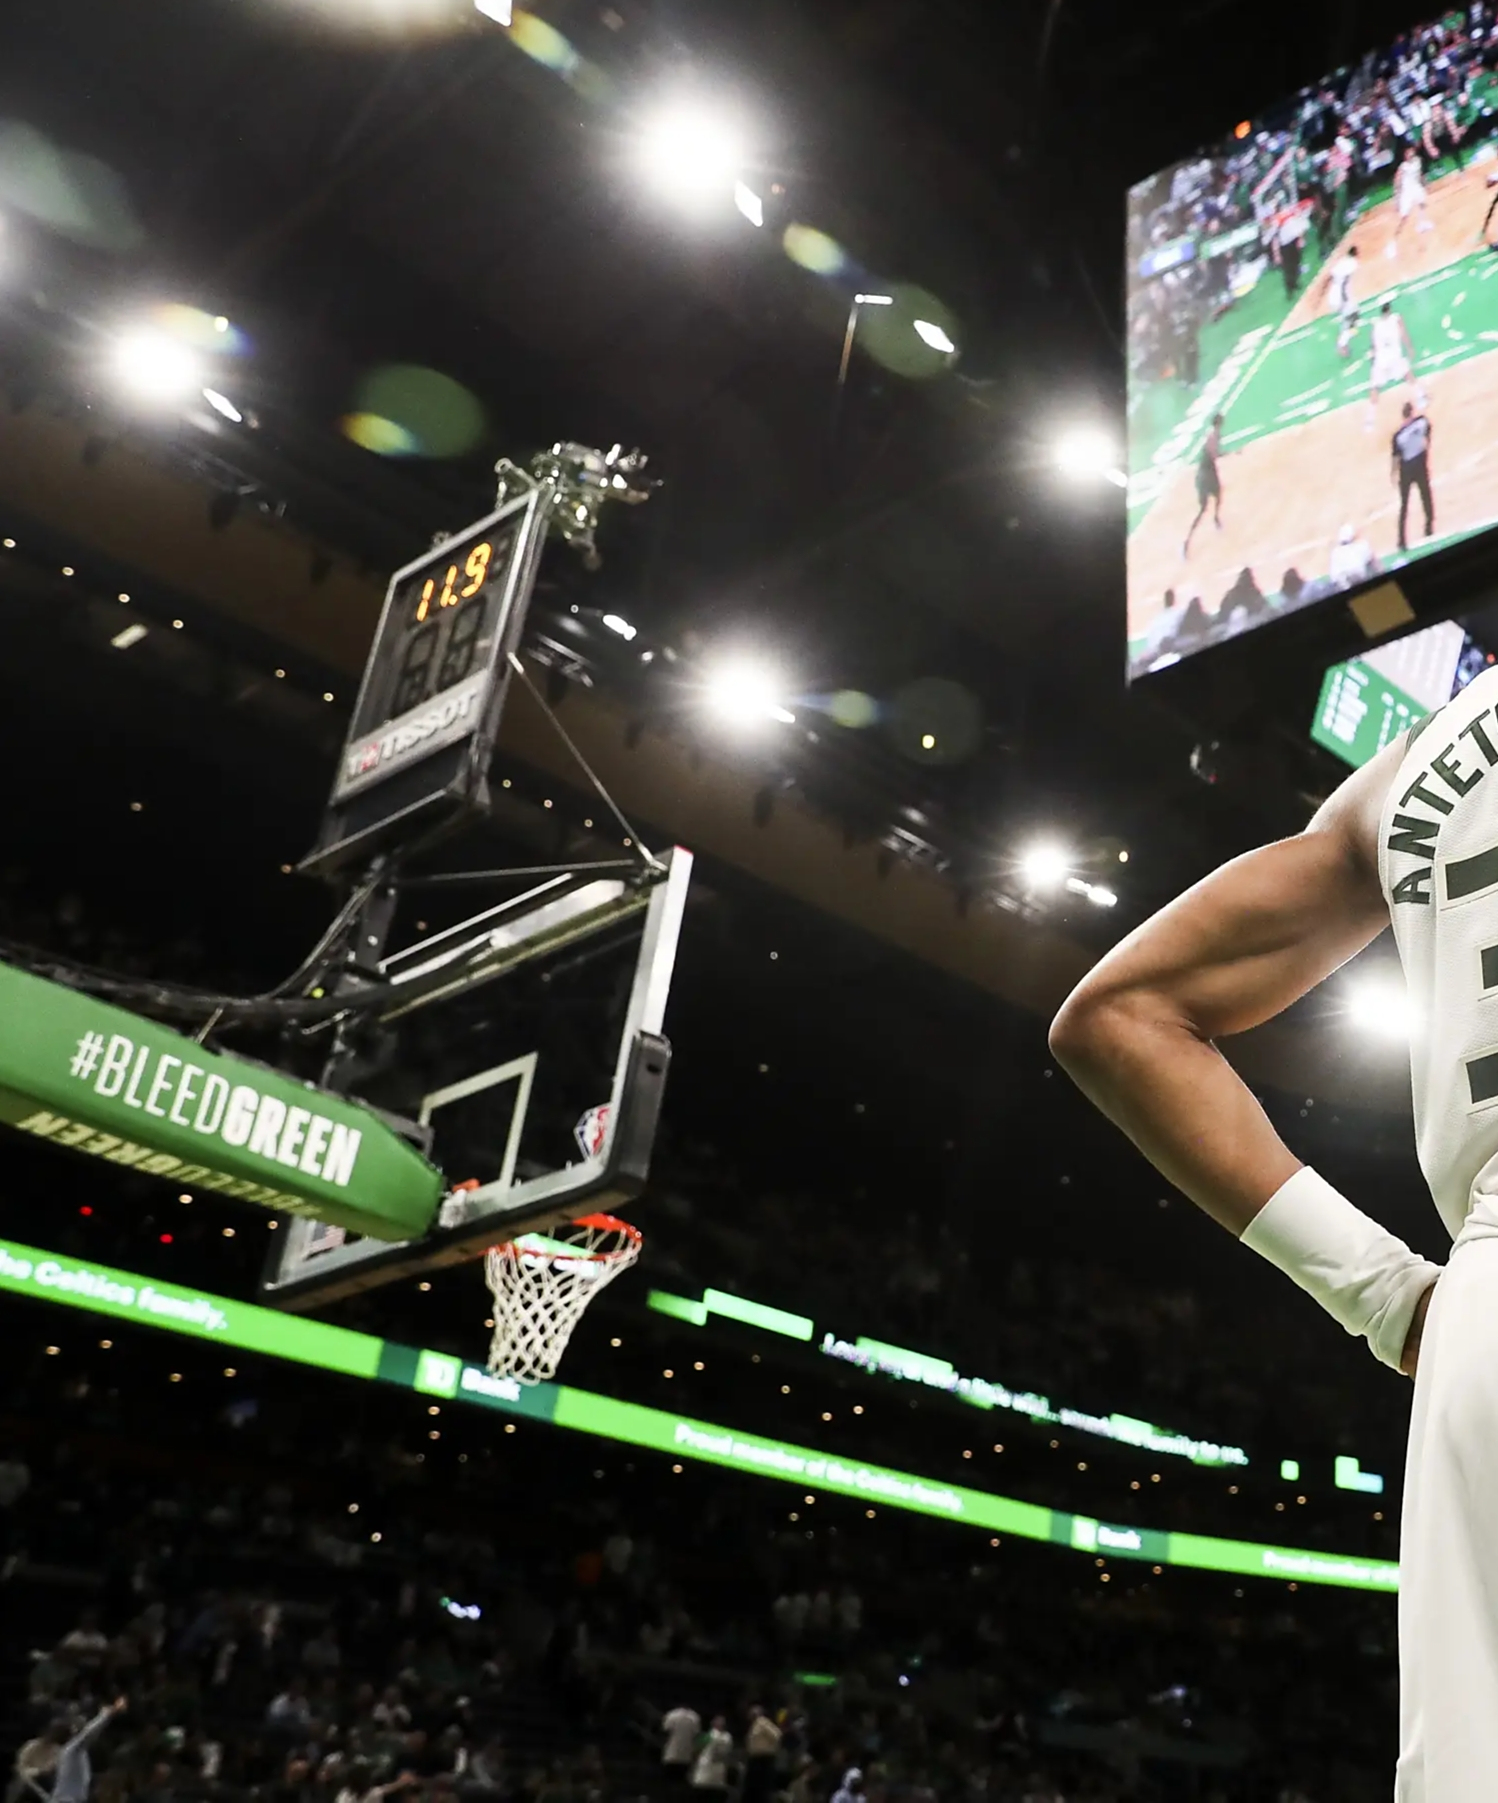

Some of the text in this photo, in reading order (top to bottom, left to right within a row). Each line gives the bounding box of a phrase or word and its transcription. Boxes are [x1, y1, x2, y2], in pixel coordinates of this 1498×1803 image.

[415, 541, 492, 622] 11.9
[70, 1030, 363, 1187] #BLEEDGREEN
[34, 1261, 136, 1306] Celtics
